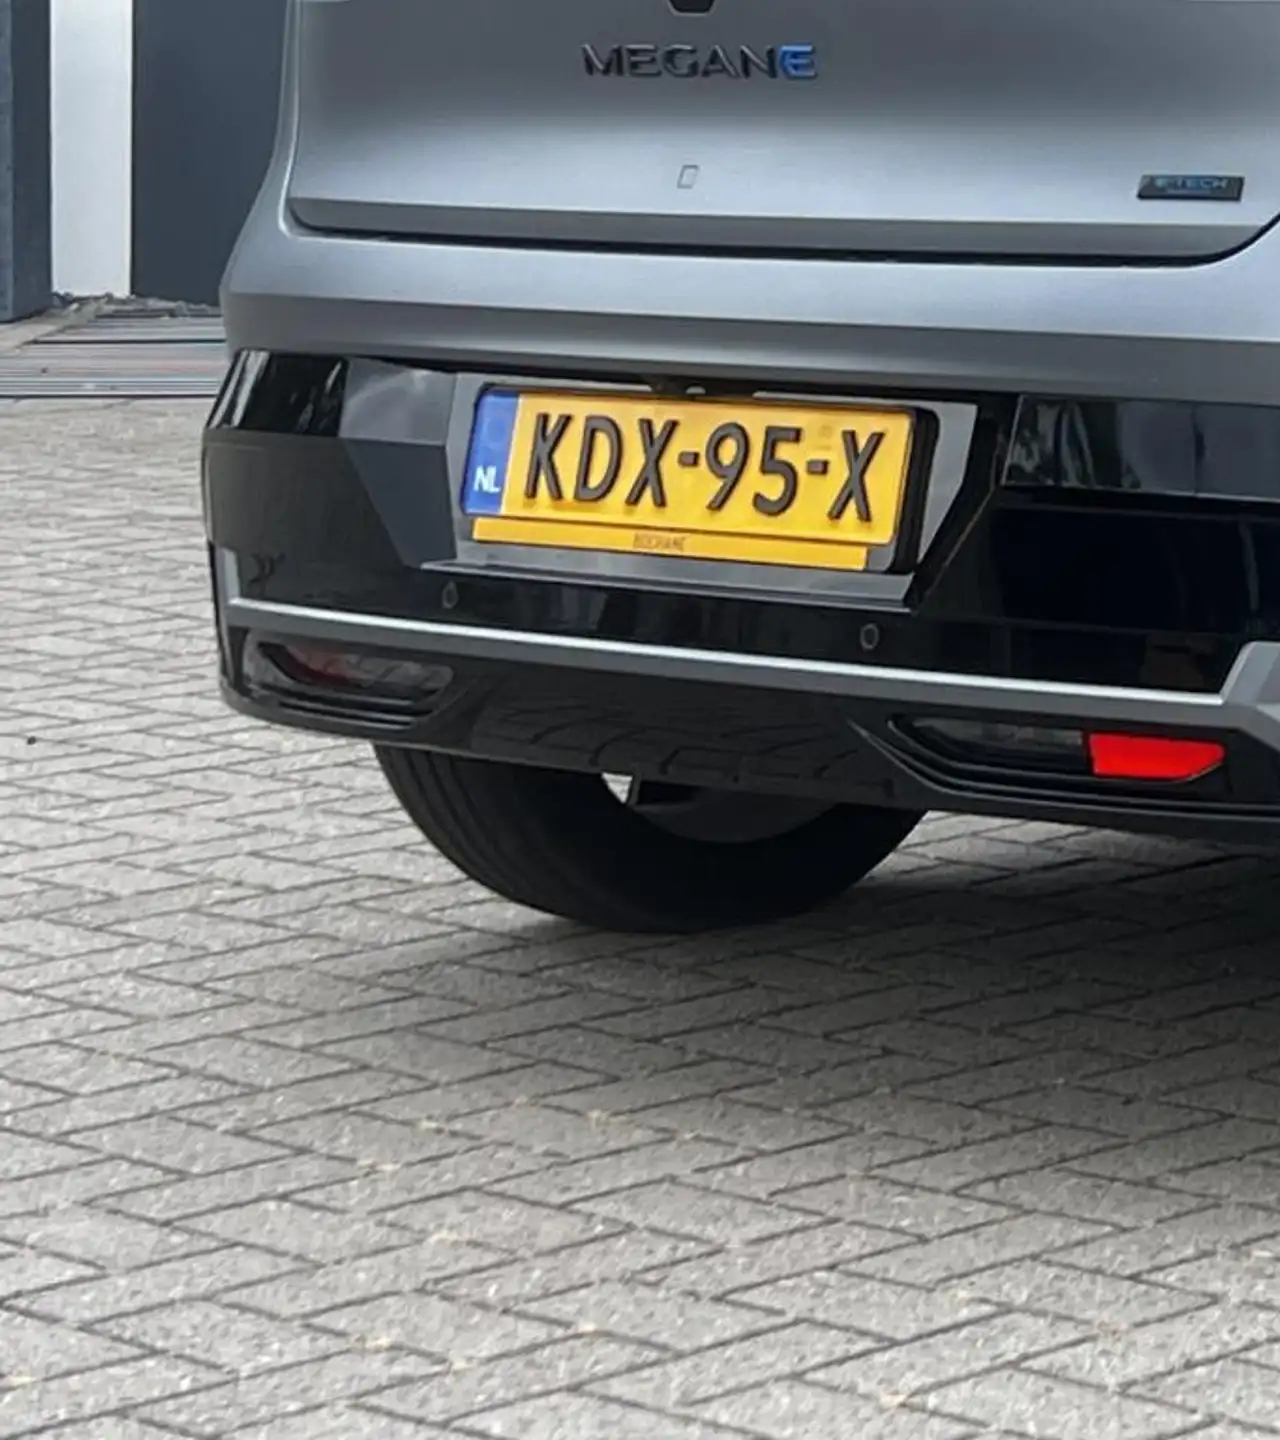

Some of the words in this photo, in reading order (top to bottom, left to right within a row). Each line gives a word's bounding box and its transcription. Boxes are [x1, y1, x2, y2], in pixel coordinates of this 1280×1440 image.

[581, 43, 818, 81] MEGANE
[473, 465, 501, 495] NL
[523, 412, 885, 523] KDX-95-X
